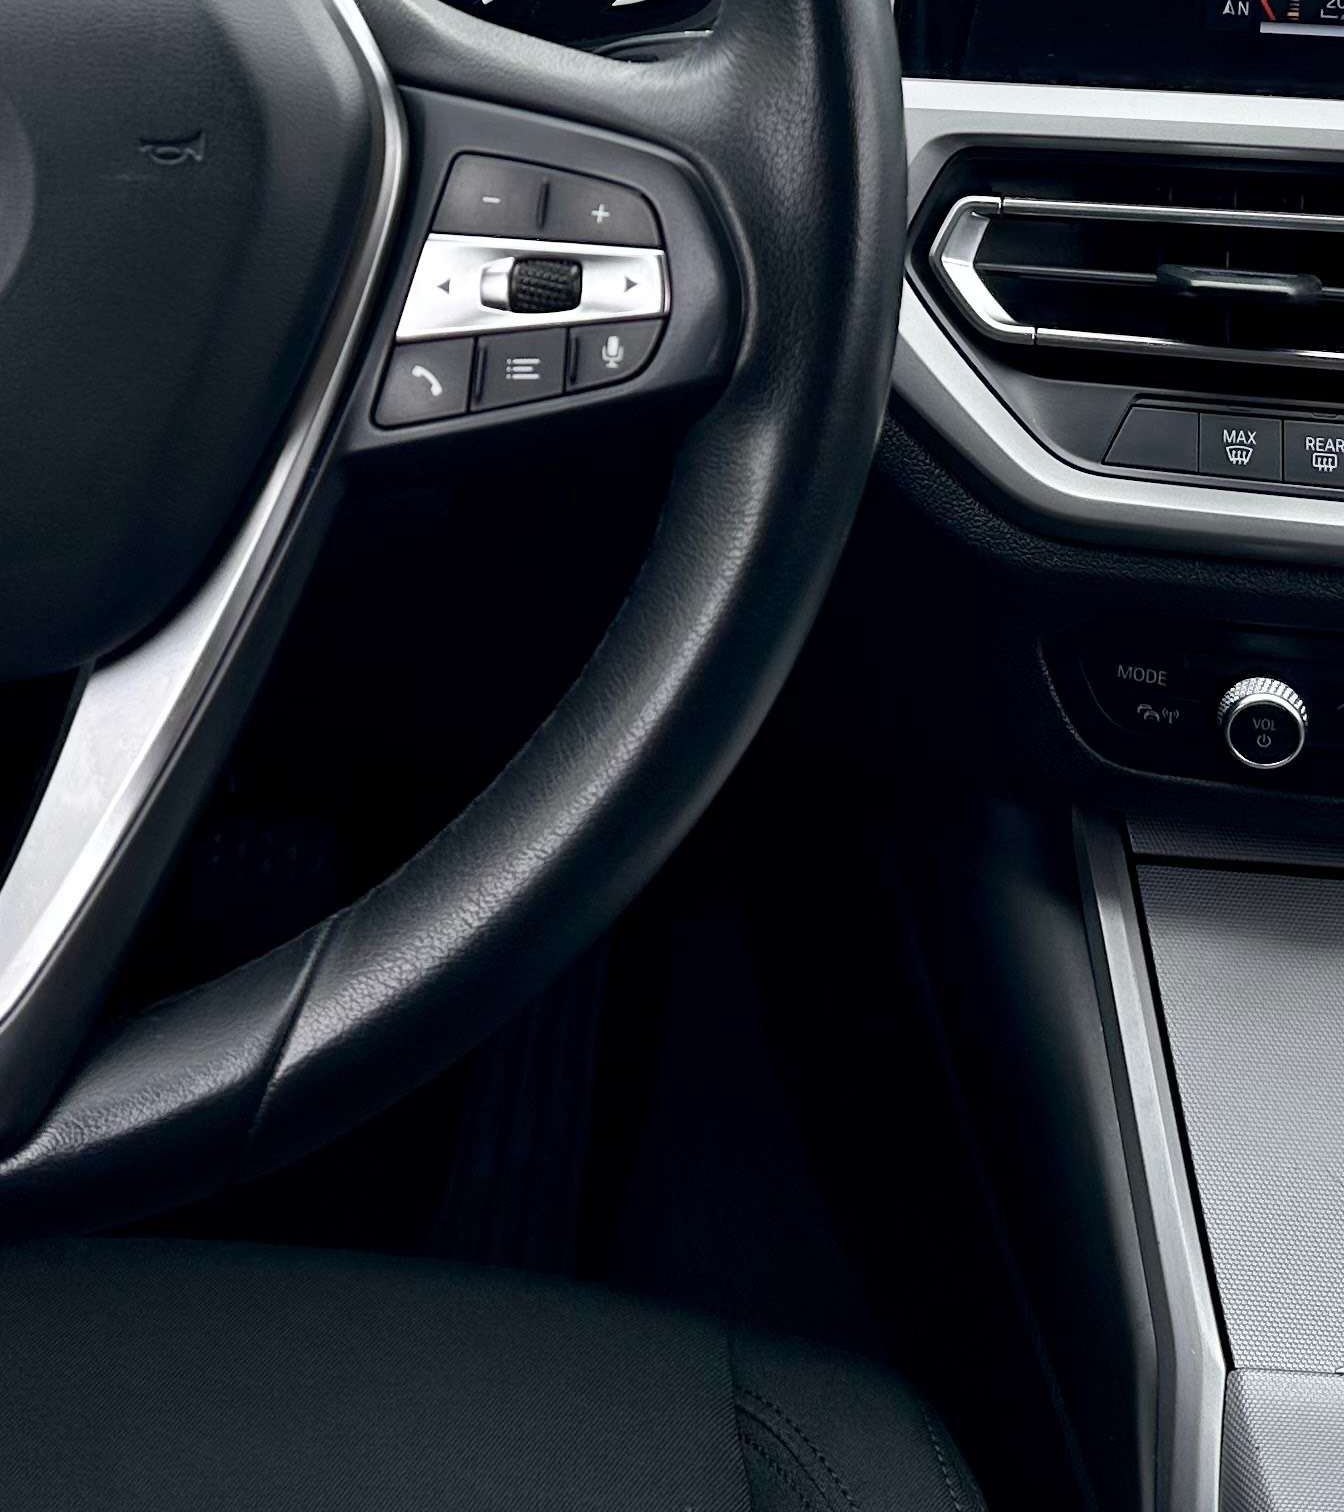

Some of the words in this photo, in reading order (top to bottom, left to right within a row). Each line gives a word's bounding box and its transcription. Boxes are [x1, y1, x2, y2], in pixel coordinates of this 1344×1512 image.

[1223, 429, 1257, 446] MAX
[1117, 664, 1168, 686] MODE
[1252, 718, 1277, 731] VOL
